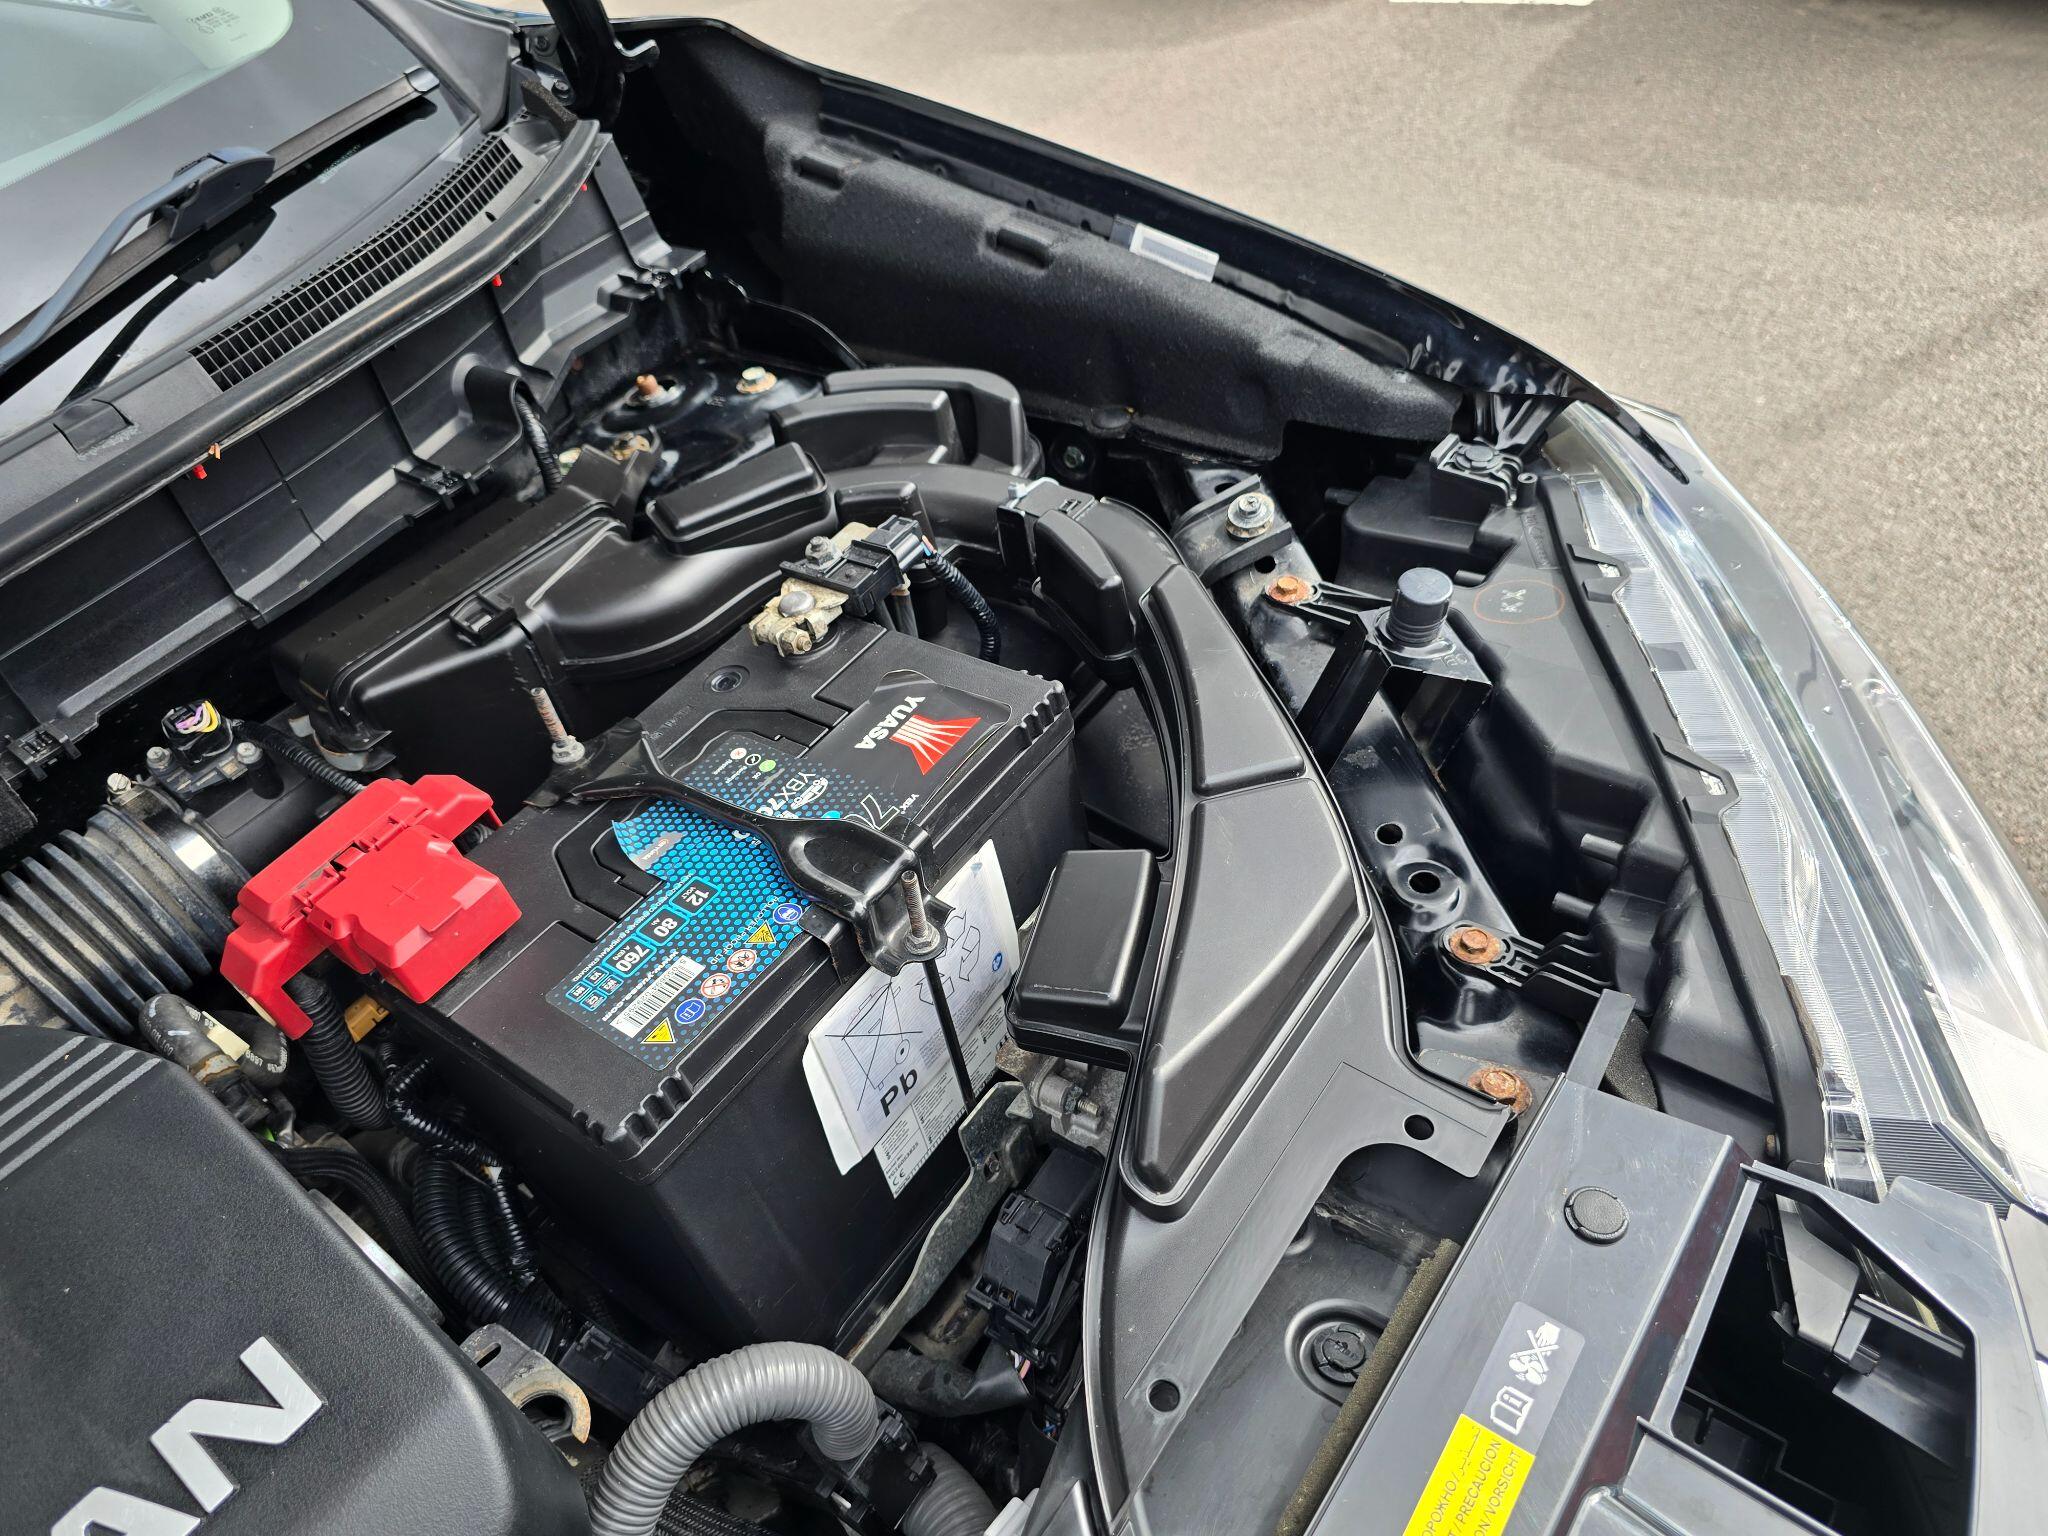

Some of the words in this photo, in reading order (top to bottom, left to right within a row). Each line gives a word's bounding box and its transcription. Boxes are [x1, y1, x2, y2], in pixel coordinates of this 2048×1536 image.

[854, 695, 925, 750] YUASA
[681, 887, 695, 899] VOLT
[688, 887, 710, 906] 12
[650, 917, 660, 926] Ah
[653, 918, 677, 937] 80
[600, 934, 625, 957] EUROPEAN
[721, 930, 747, 954] PROOF
[572, 956, 600, 982] STANDARD
[616, 945, 649, 972] 760
[709, 953, 723, 965] LID
[601, 950, 679, 1021] www.yuasa.com
[880, 1069, 918, 1117] Pb
